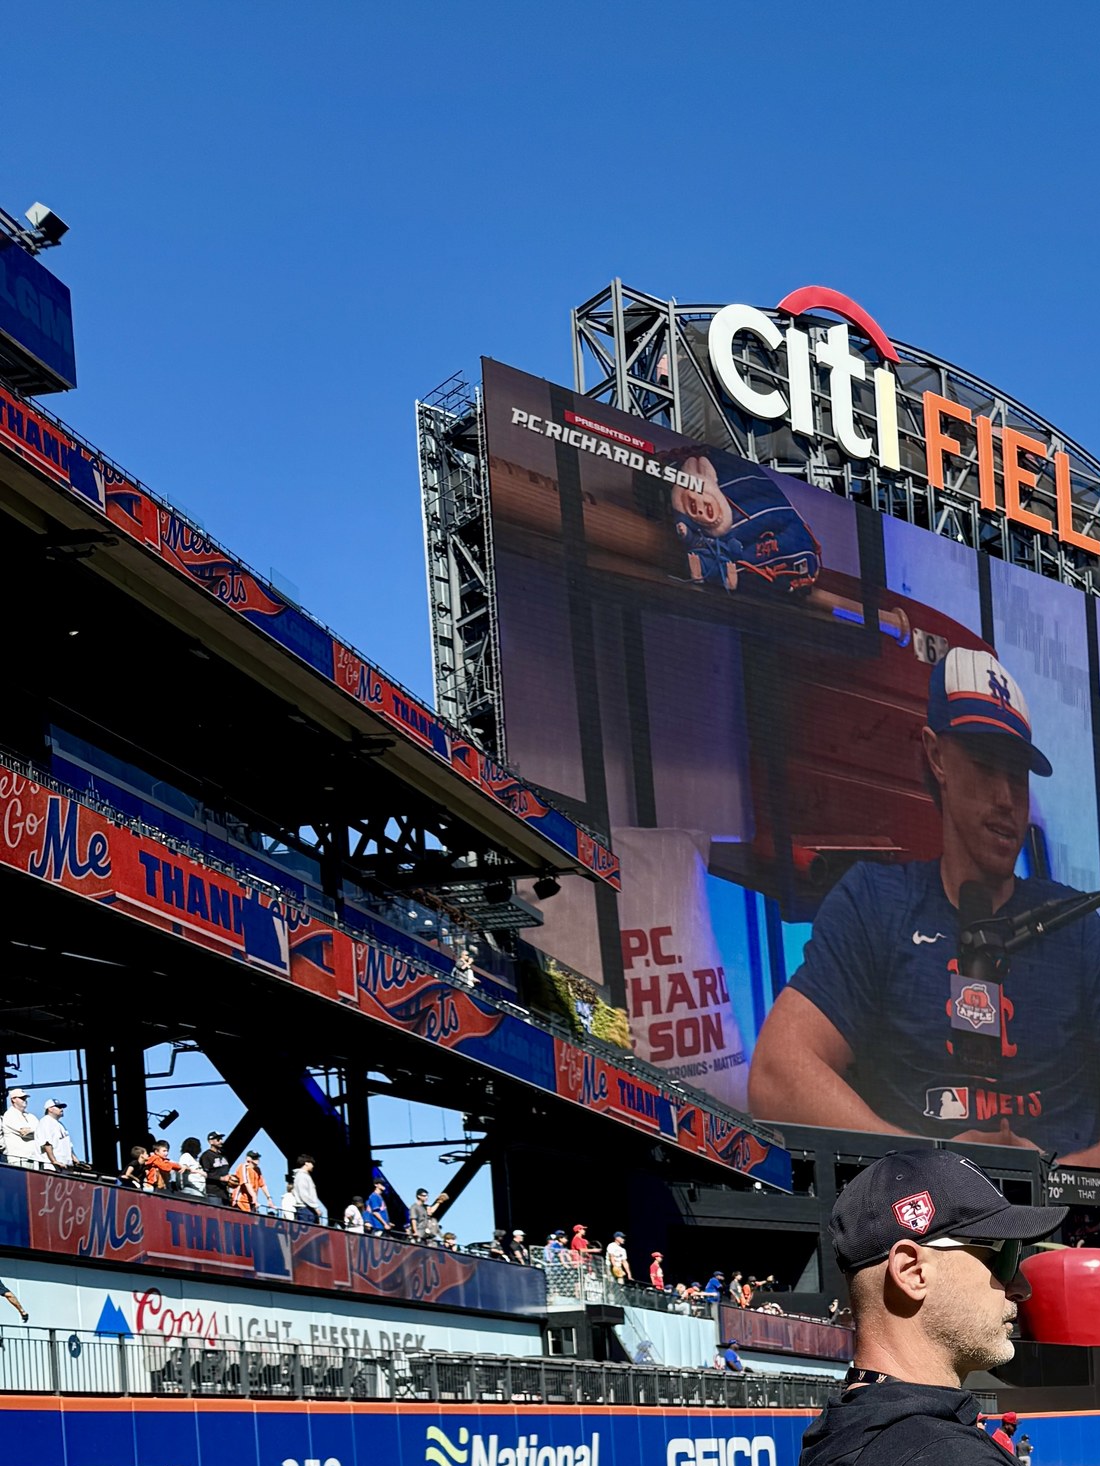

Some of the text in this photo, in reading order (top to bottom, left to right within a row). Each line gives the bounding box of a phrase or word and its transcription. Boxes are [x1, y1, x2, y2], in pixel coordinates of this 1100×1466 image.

[708, 303, 901, 472] citi
[543, 420, 644, 471] RICHARD
[645, 458, 662, 479] &
[662, 465, 705, 494] SON
[574, 415, 645, 449] PRESENTED BY
[4, 798, 44, 848] Go
[29, 796, 111, 882] Me
[620, 926, 682, 969] P.C.
[648, 1012, 726, 1062] SON
[1061, 1173, 1075, 1185] PM
[1078, 1189, 1096, 1200] THAT
[58, 1199, 90, 1240] Go
[79, 1187, 143, 1257] Me
